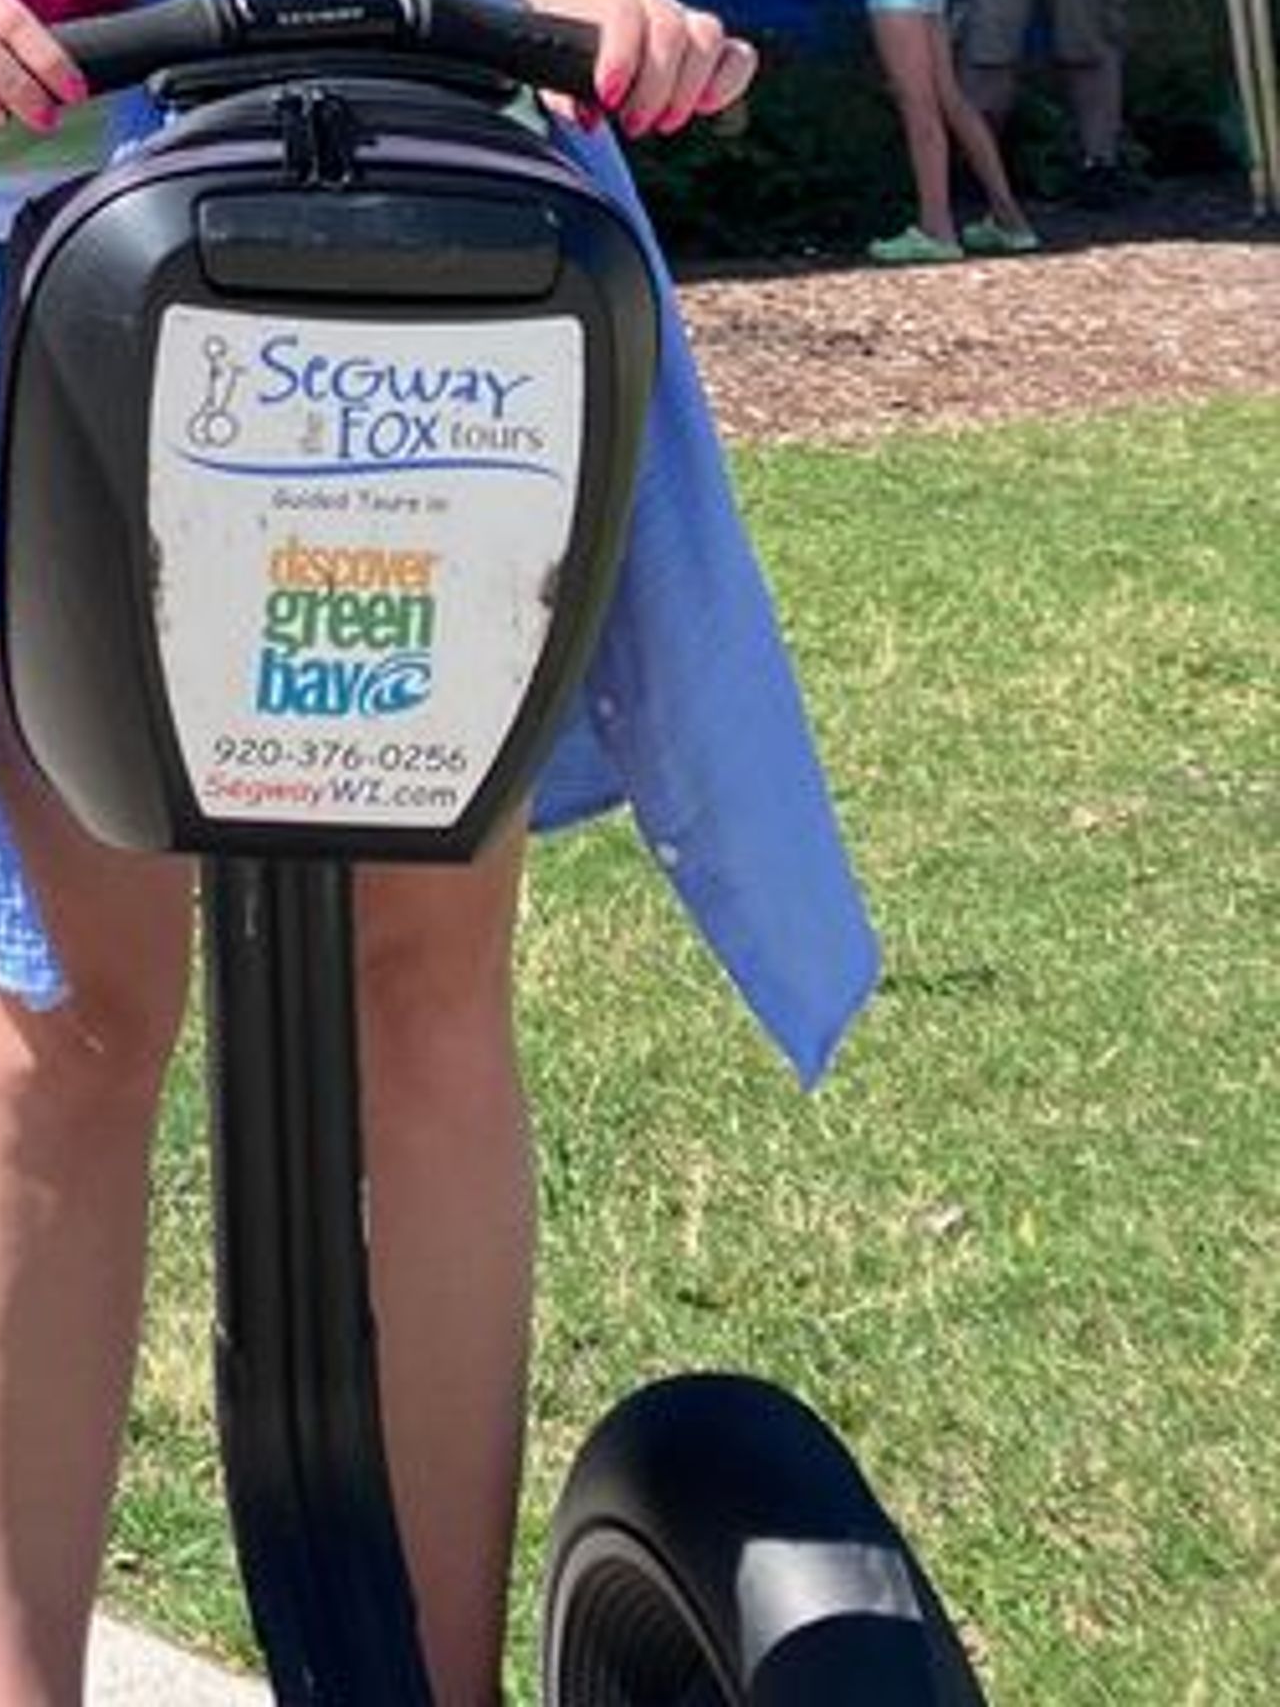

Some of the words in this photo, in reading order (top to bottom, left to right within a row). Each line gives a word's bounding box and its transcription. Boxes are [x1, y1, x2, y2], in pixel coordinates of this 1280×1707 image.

[449, 419, 545, 452] tours
[268, 535, 437, 589] discover
[265, 587, 436, 658] green
[256, 648, 366, 717] bay
[213, 736, 468, 774] 920-376-0256
